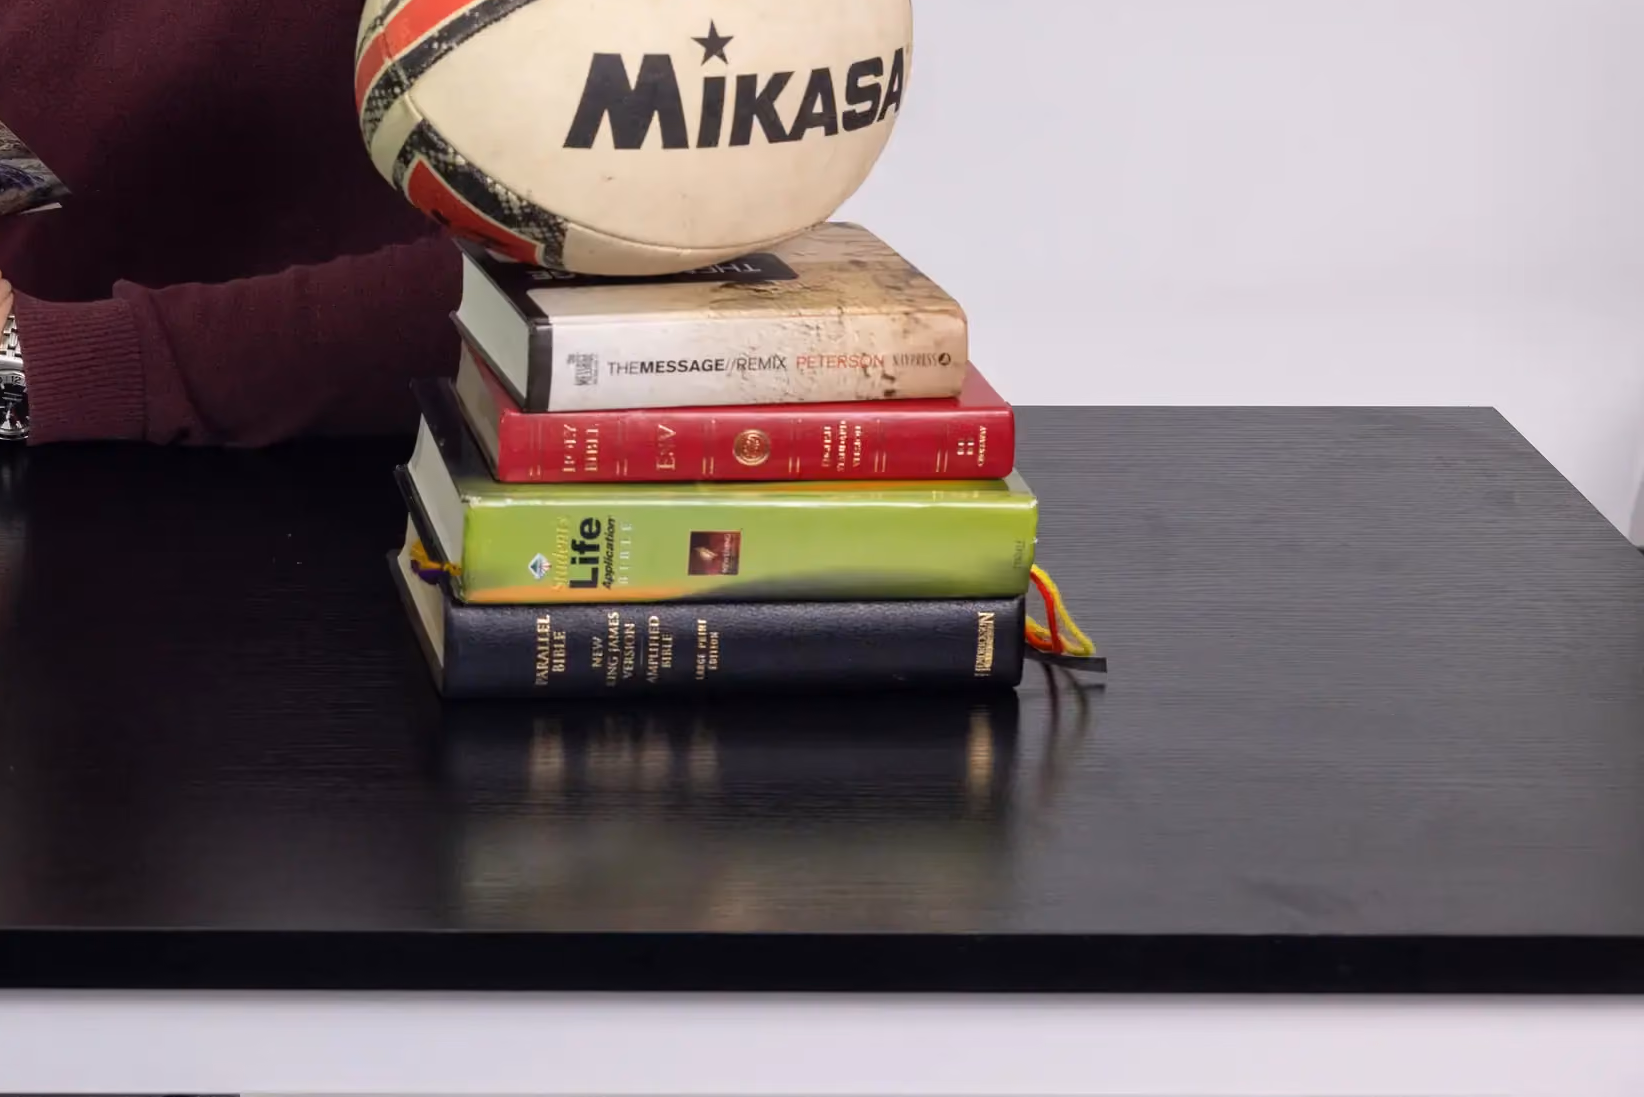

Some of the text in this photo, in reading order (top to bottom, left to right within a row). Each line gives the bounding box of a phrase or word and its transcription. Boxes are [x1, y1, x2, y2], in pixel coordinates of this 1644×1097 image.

[11, 375, 22, 384] 12
[796, 354, 885, 369] PETERSON
[569, 517, 602, 589] Life
[602, 517, 616, 591] Application
[618, 523, 633, 585] BIBLE
[535, 614, 551, 686] PARALLEL
[552, 631, 566, 672] BIBLE
[591, 636, 603, 668] NEW
[607, 611, 621, 653] JAMES
[622, 623, 636, 679] VERSION
[646, 615, 660, 684] AMPLIFIED
[661, 633, 673, 669] BIBLE
